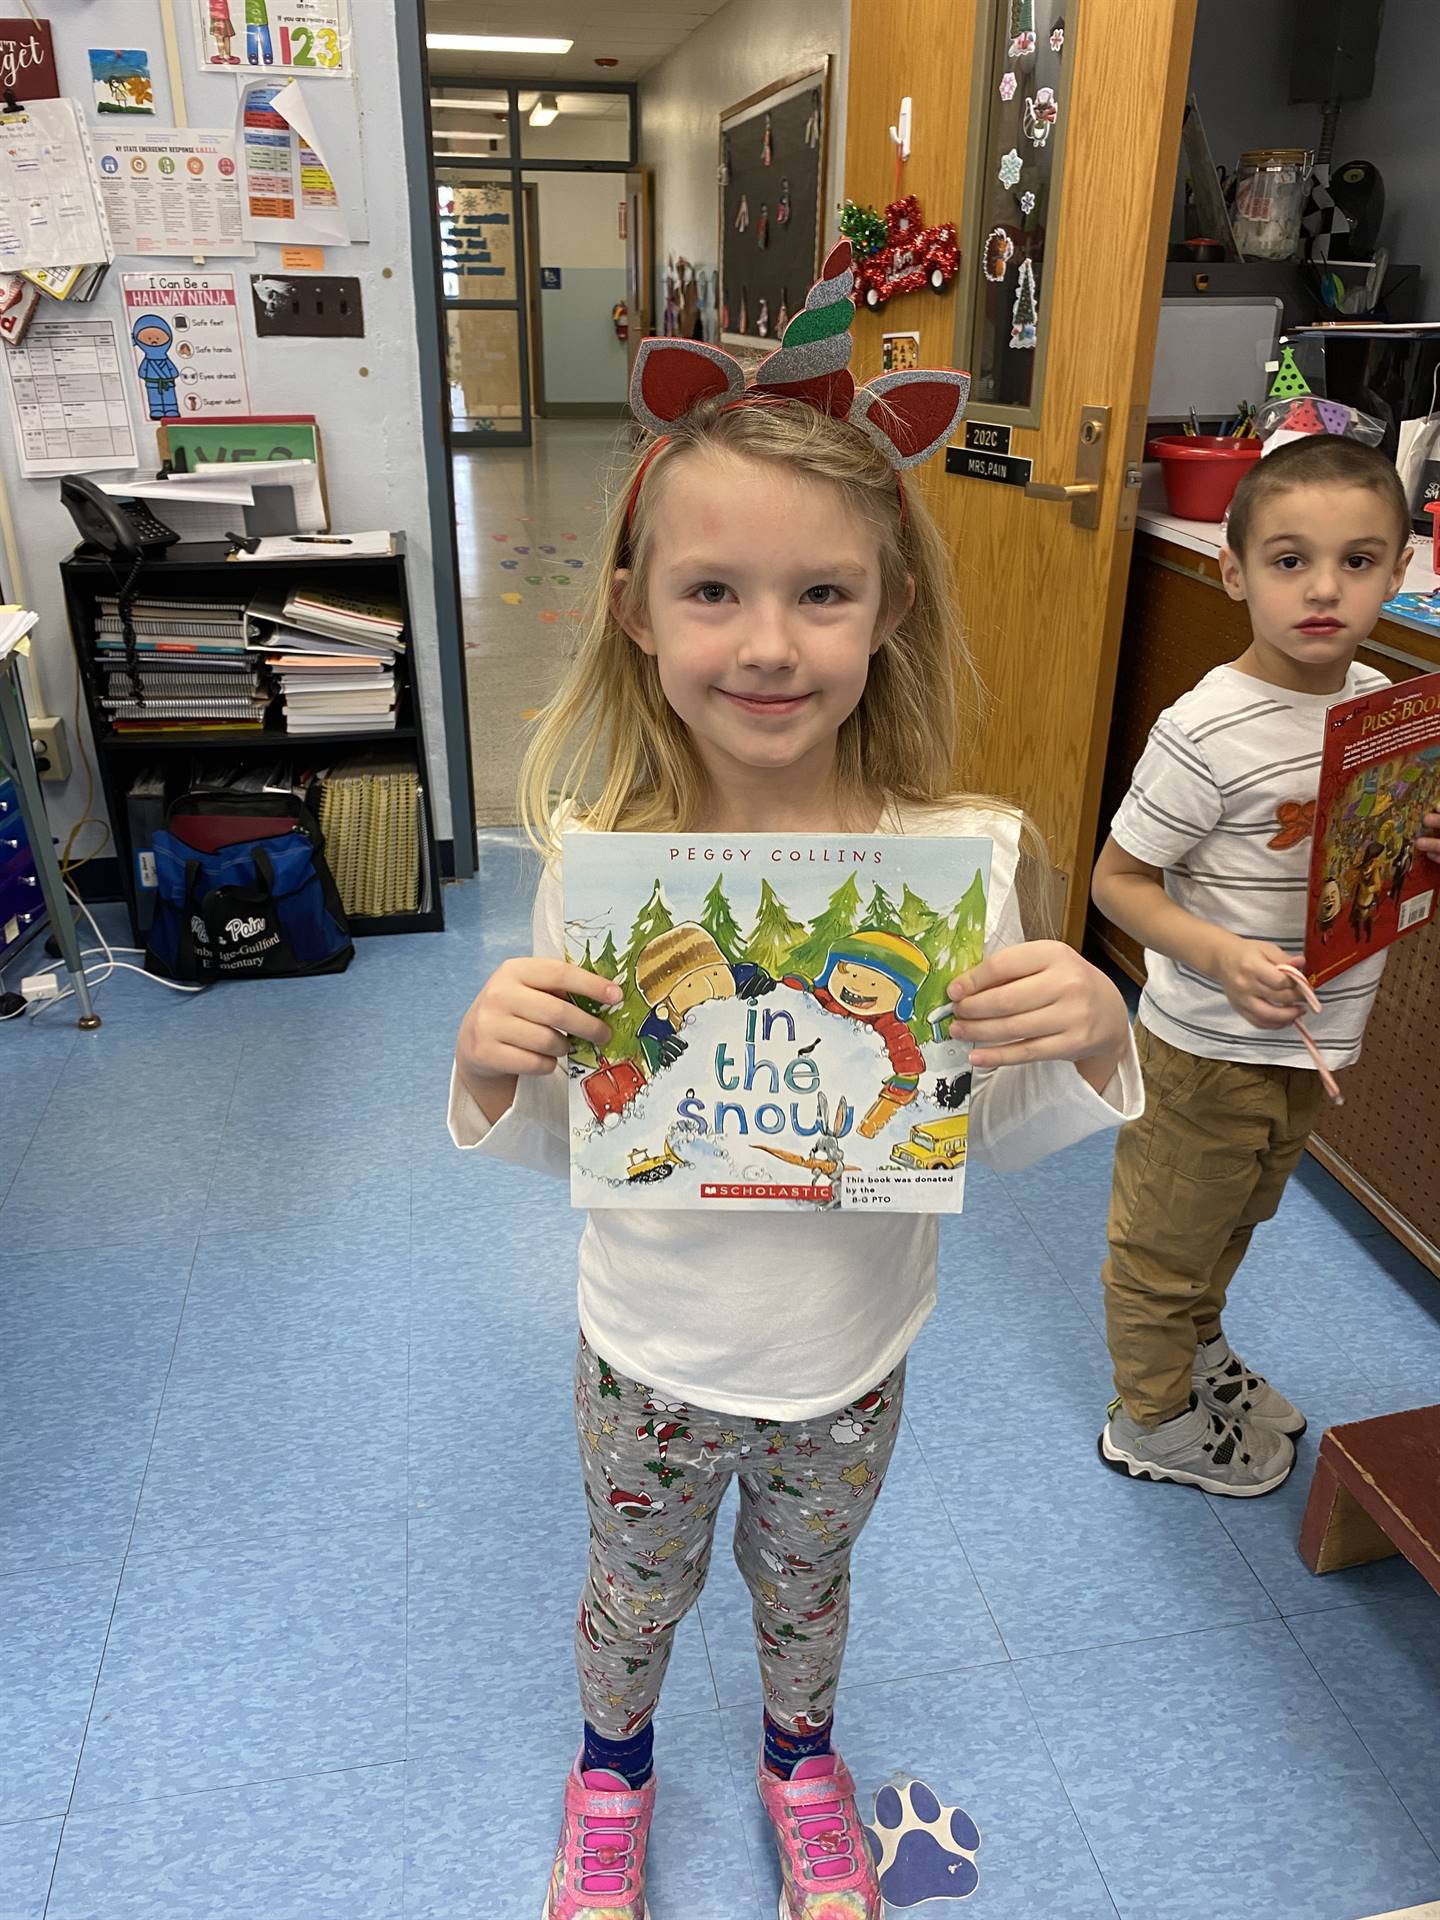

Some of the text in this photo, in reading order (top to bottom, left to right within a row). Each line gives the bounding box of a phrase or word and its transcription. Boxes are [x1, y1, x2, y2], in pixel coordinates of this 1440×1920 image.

[149, 277, 209, 289] I Can Be a
[132, 290, 229, 306] HALLWAY NINJA
[192, 319, 224, 327] Safe feet
[195, 346, 212, 354] Safe
[199, 372, 215, 381] Eyes
[203, 397, 241, 407] Super silent
[973, 429, 998, 447] 202C
[1361, 707, 1397, 736] PUSS
[669, 847, 882, 864] PEGGY COLLINS
[225, 917, 266, 942] Pain
[202, 956, 264, 969] Ementary
[745, 998, 796, 1043] in
[715, 1042, 821, 1095] the
[676, 1096, 855, 1139] snow
[846, 1176, 865, 1184] This
[867, 1176, 892, 1184] book
[914, 1175, 954, 1183] donated
[719, 1185, 830, 1198] SCHOLASTIC
[845, 1186, 876, 1195] by the
[871, 1196, 892, 1204] PTO
